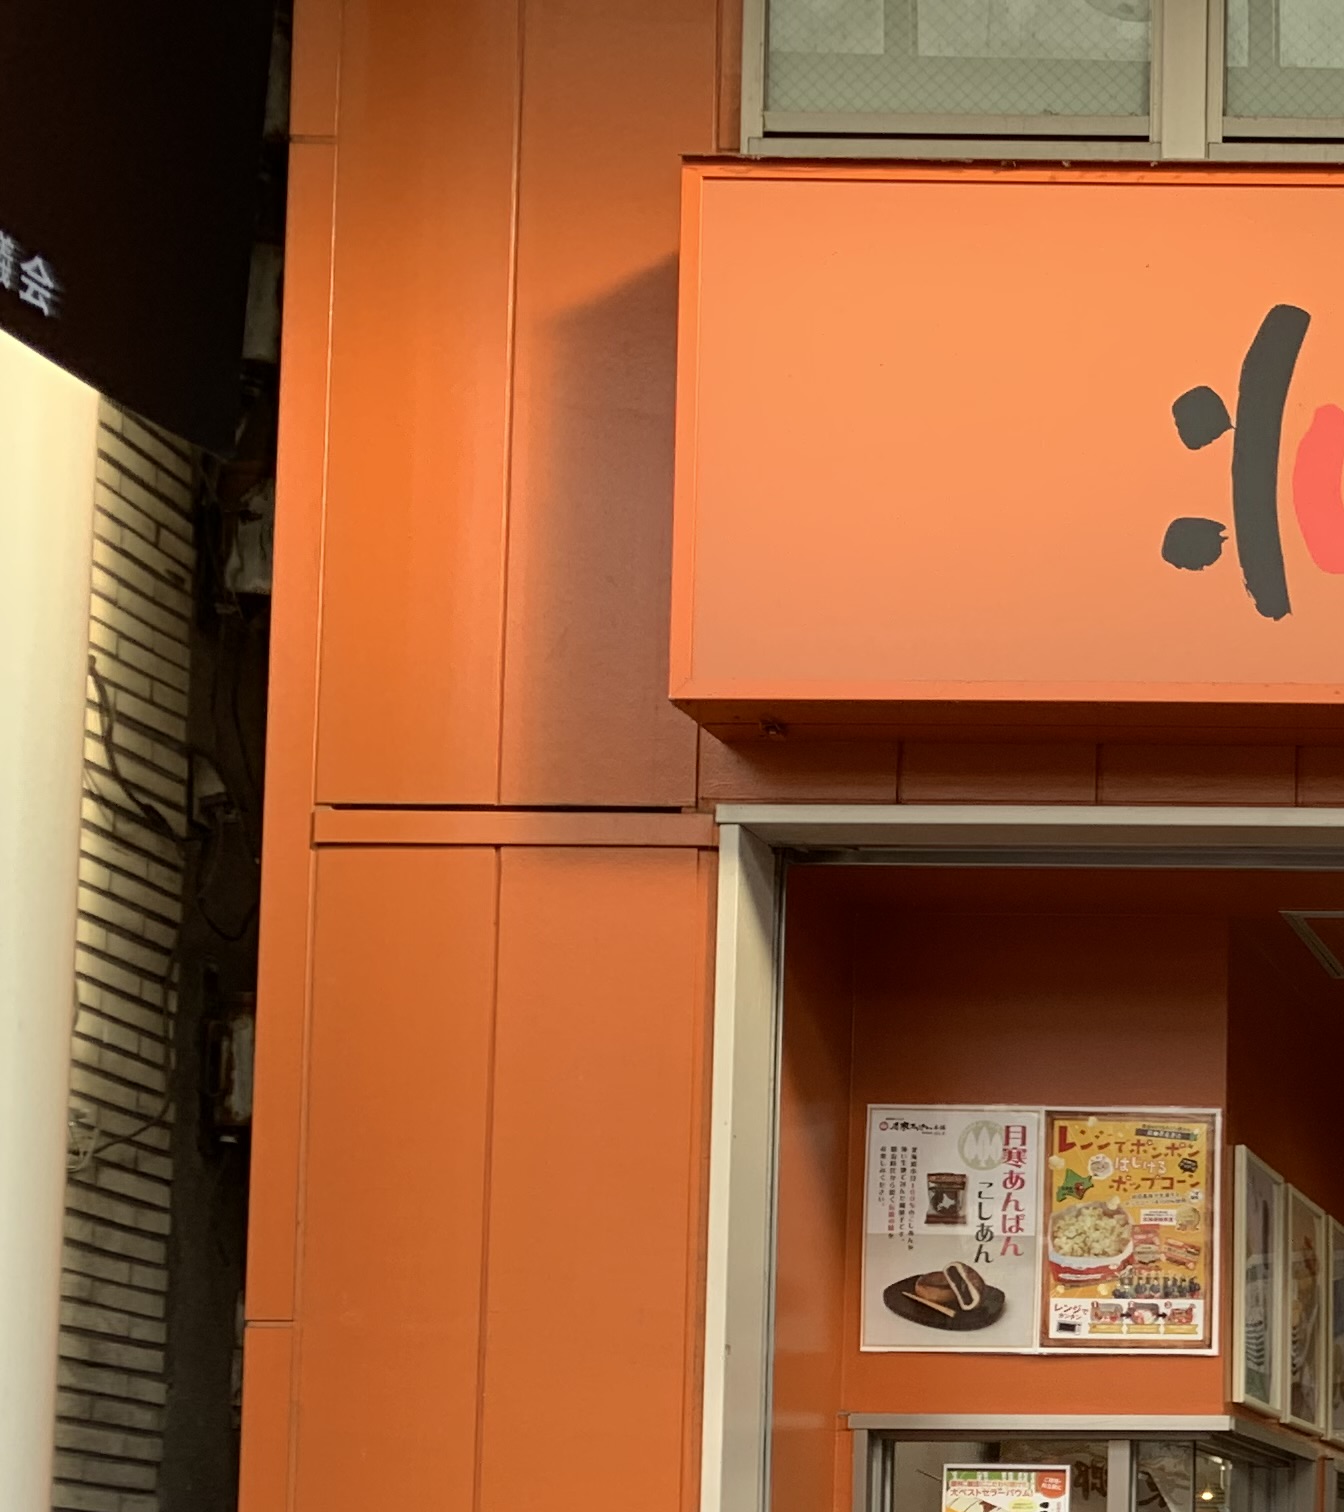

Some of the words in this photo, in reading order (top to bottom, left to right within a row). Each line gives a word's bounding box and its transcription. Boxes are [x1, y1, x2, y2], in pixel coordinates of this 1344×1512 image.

[974, 1181, 995, 1264] こしあん
[1000, 1125, 1027, 1257] 月寒あんぱん
[1109, 1174, 1200, 1192] ポップコーン
